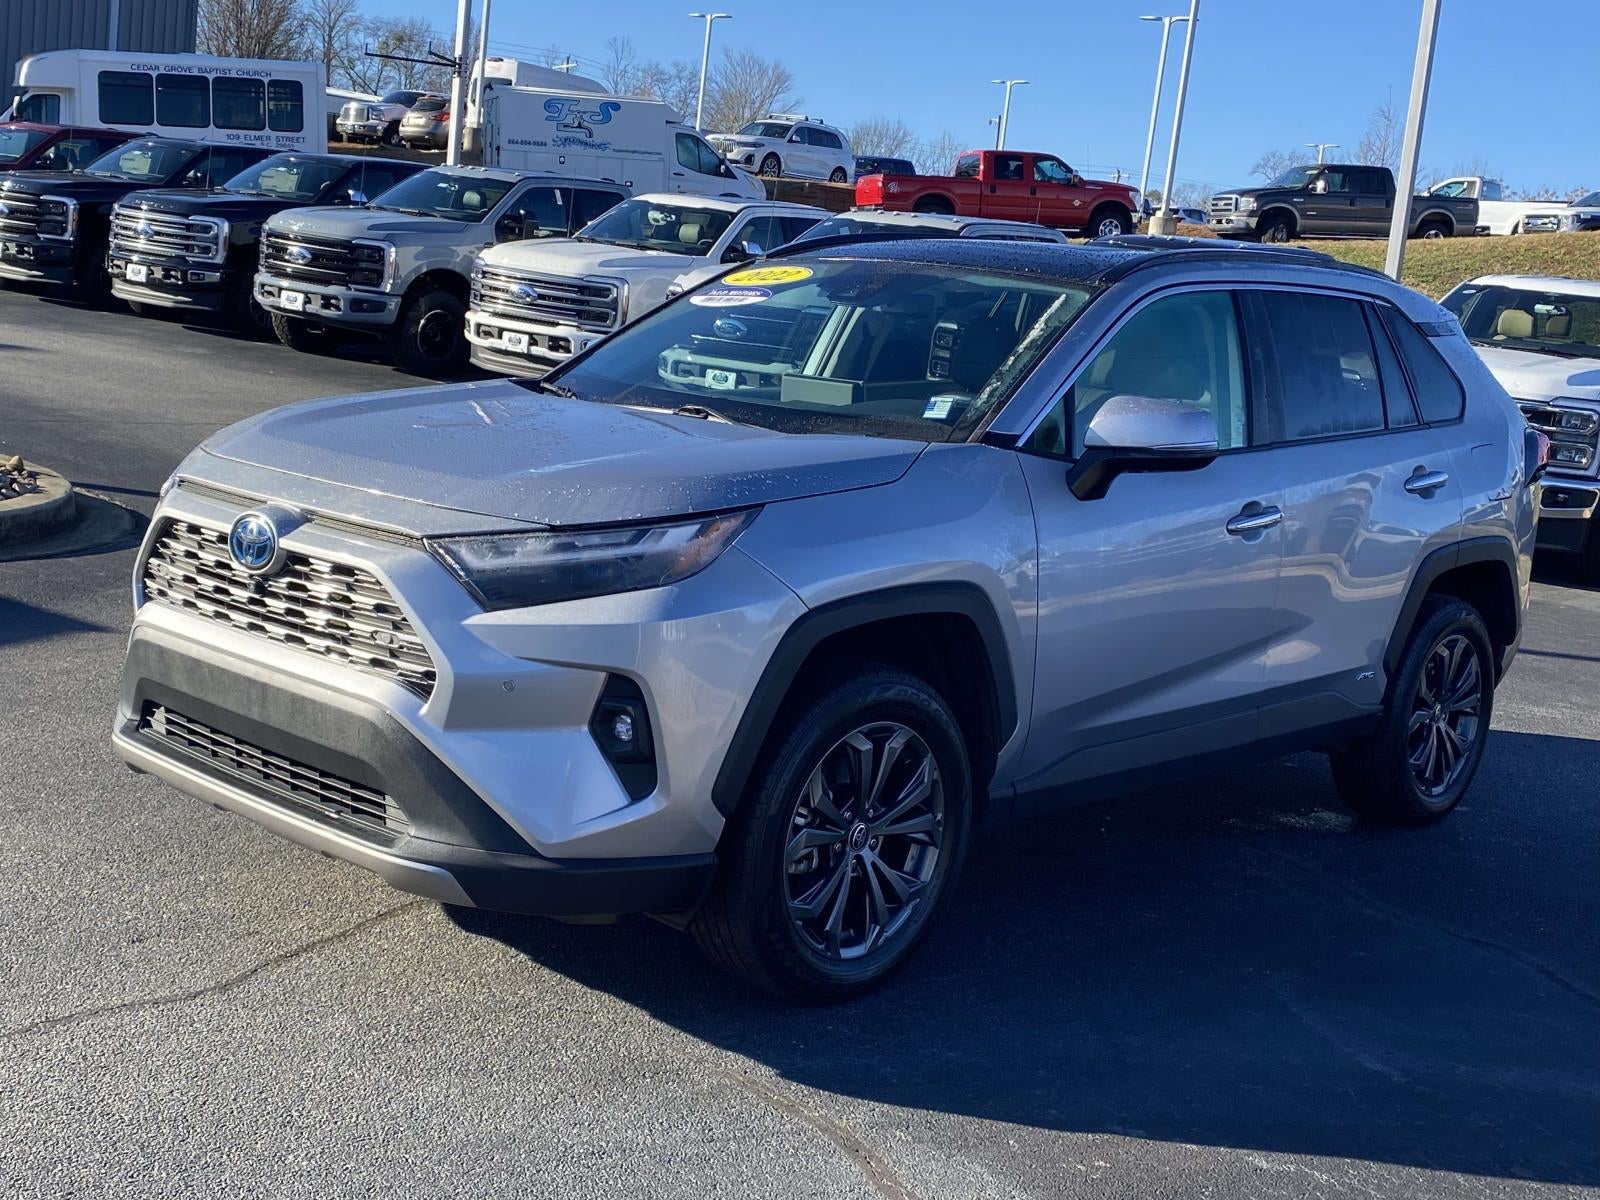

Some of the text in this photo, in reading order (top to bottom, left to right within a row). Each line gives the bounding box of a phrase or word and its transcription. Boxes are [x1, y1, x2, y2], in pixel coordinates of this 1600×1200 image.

[130, 63, 272, 78] CEDAR GROVE BAPTIST CHURCH
[226, 133, 306, 144] 109 ELMER STREET
